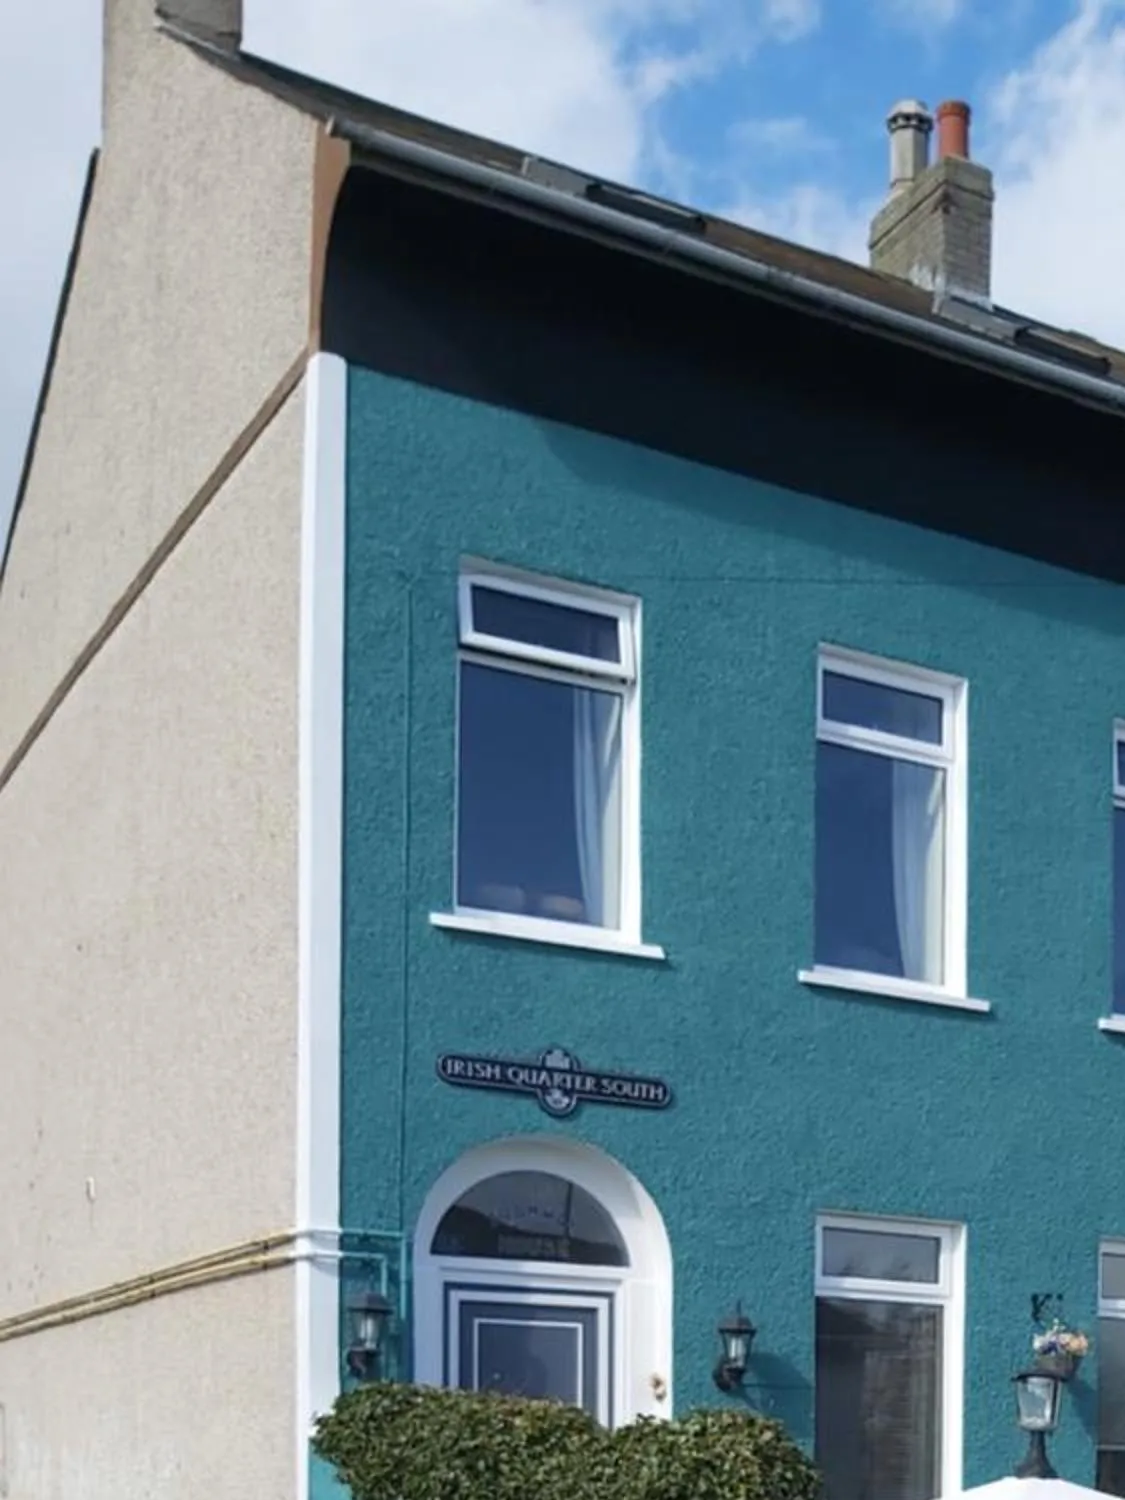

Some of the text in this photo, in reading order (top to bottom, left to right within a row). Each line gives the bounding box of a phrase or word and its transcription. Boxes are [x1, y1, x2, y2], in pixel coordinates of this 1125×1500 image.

[446, 1058, 664, 1100] IRISH QUARTER SOUTH
